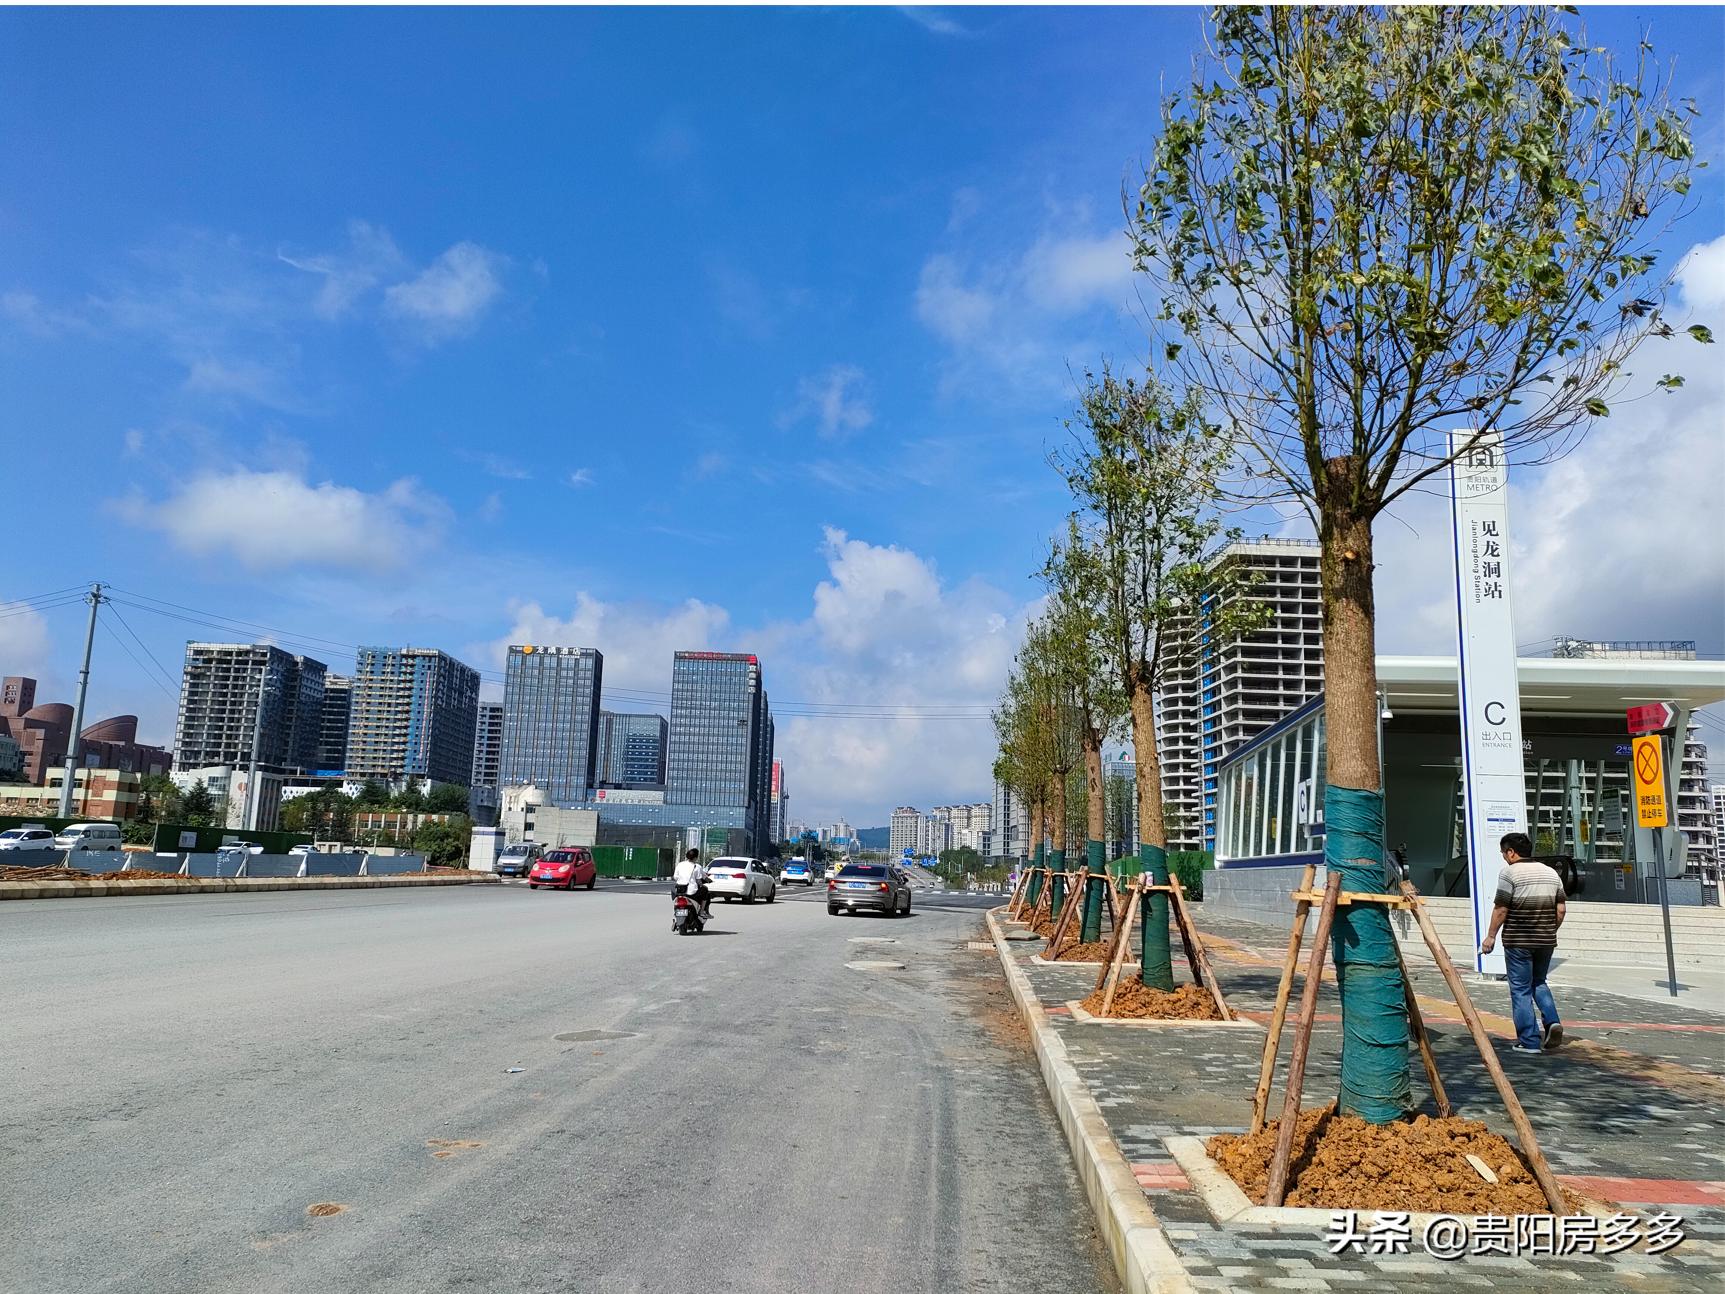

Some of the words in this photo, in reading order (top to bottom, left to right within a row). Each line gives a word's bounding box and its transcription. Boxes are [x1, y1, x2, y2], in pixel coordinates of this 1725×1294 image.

[1472, 520, 1480, 573] Jianlongdong
[1481, 520, 1502, 599] 见龙洞站
[1484, 701, 1506, 725] C
[1481, 730, 1511, 740] 出入口
[1300, 790, 1305, 812] C
